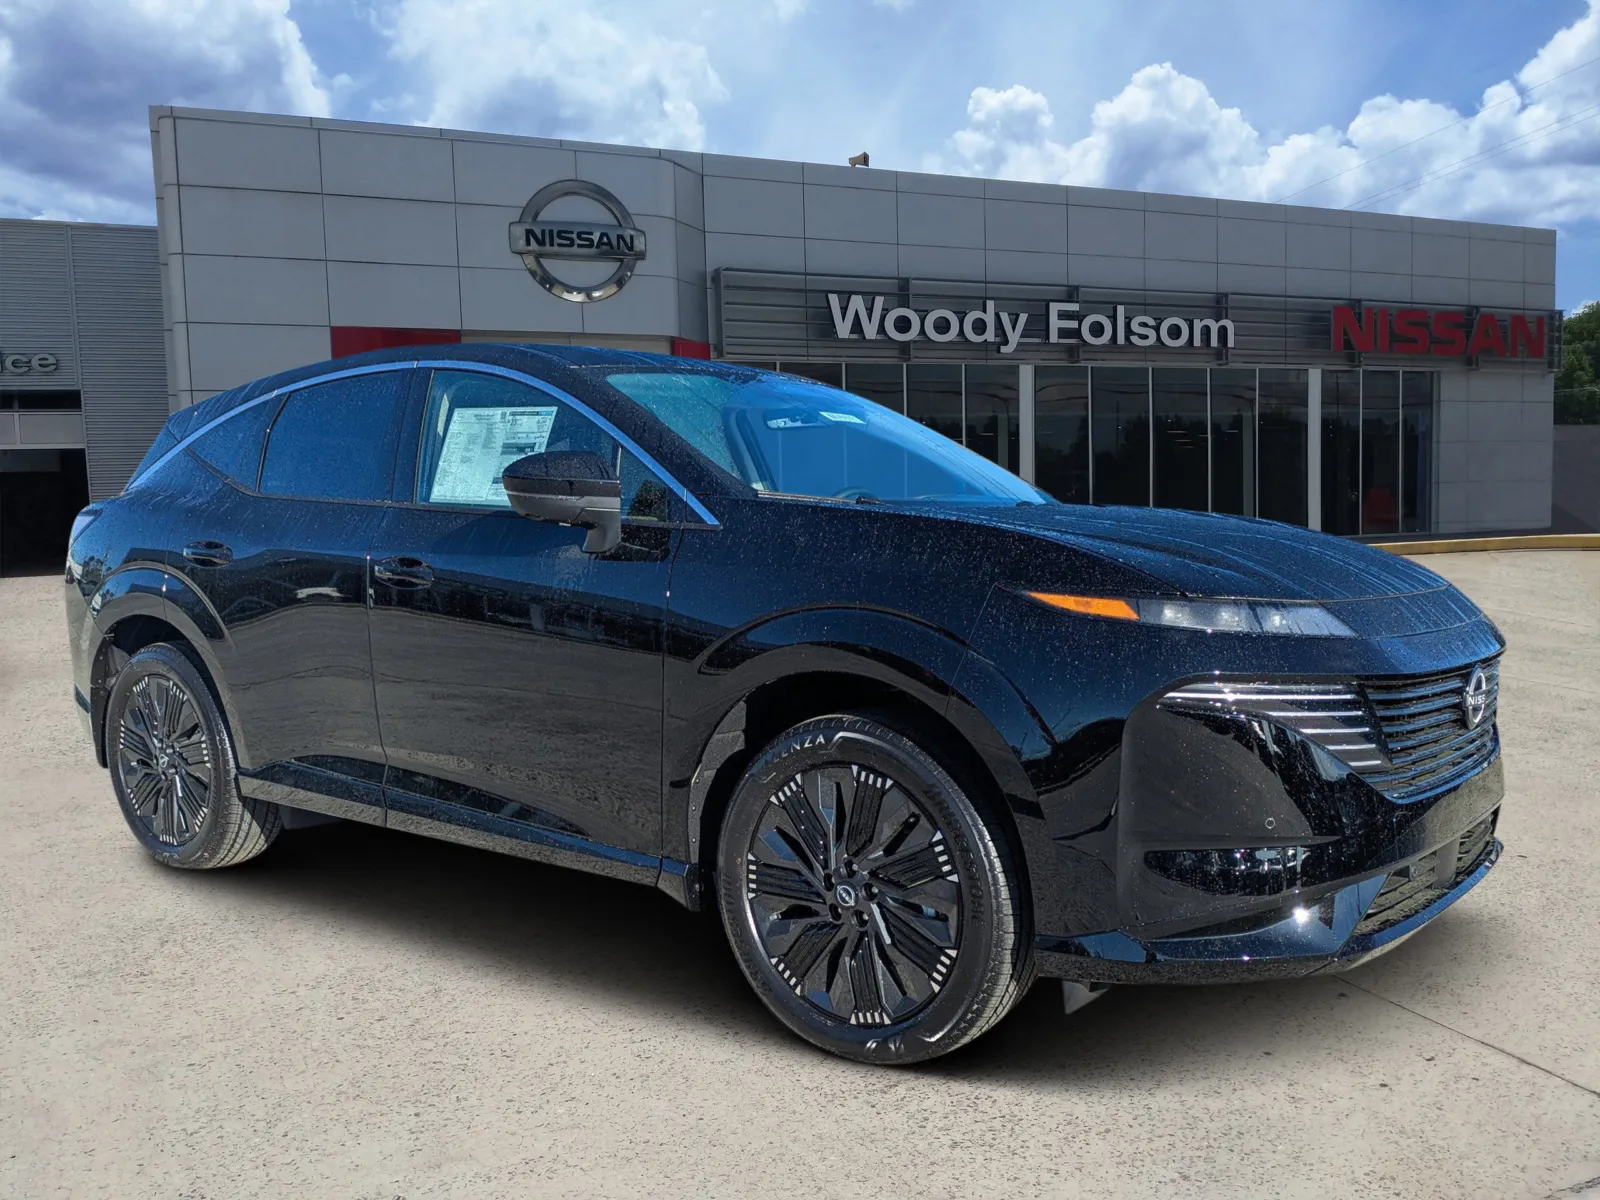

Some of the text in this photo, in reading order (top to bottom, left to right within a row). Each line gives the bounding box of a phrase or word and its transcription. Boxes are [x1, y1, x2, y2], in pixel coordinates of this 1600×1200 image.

[524, 228, 635, 253] NISSAN
[826, 292, 1545, 359] Woody Folsom NISSAN
